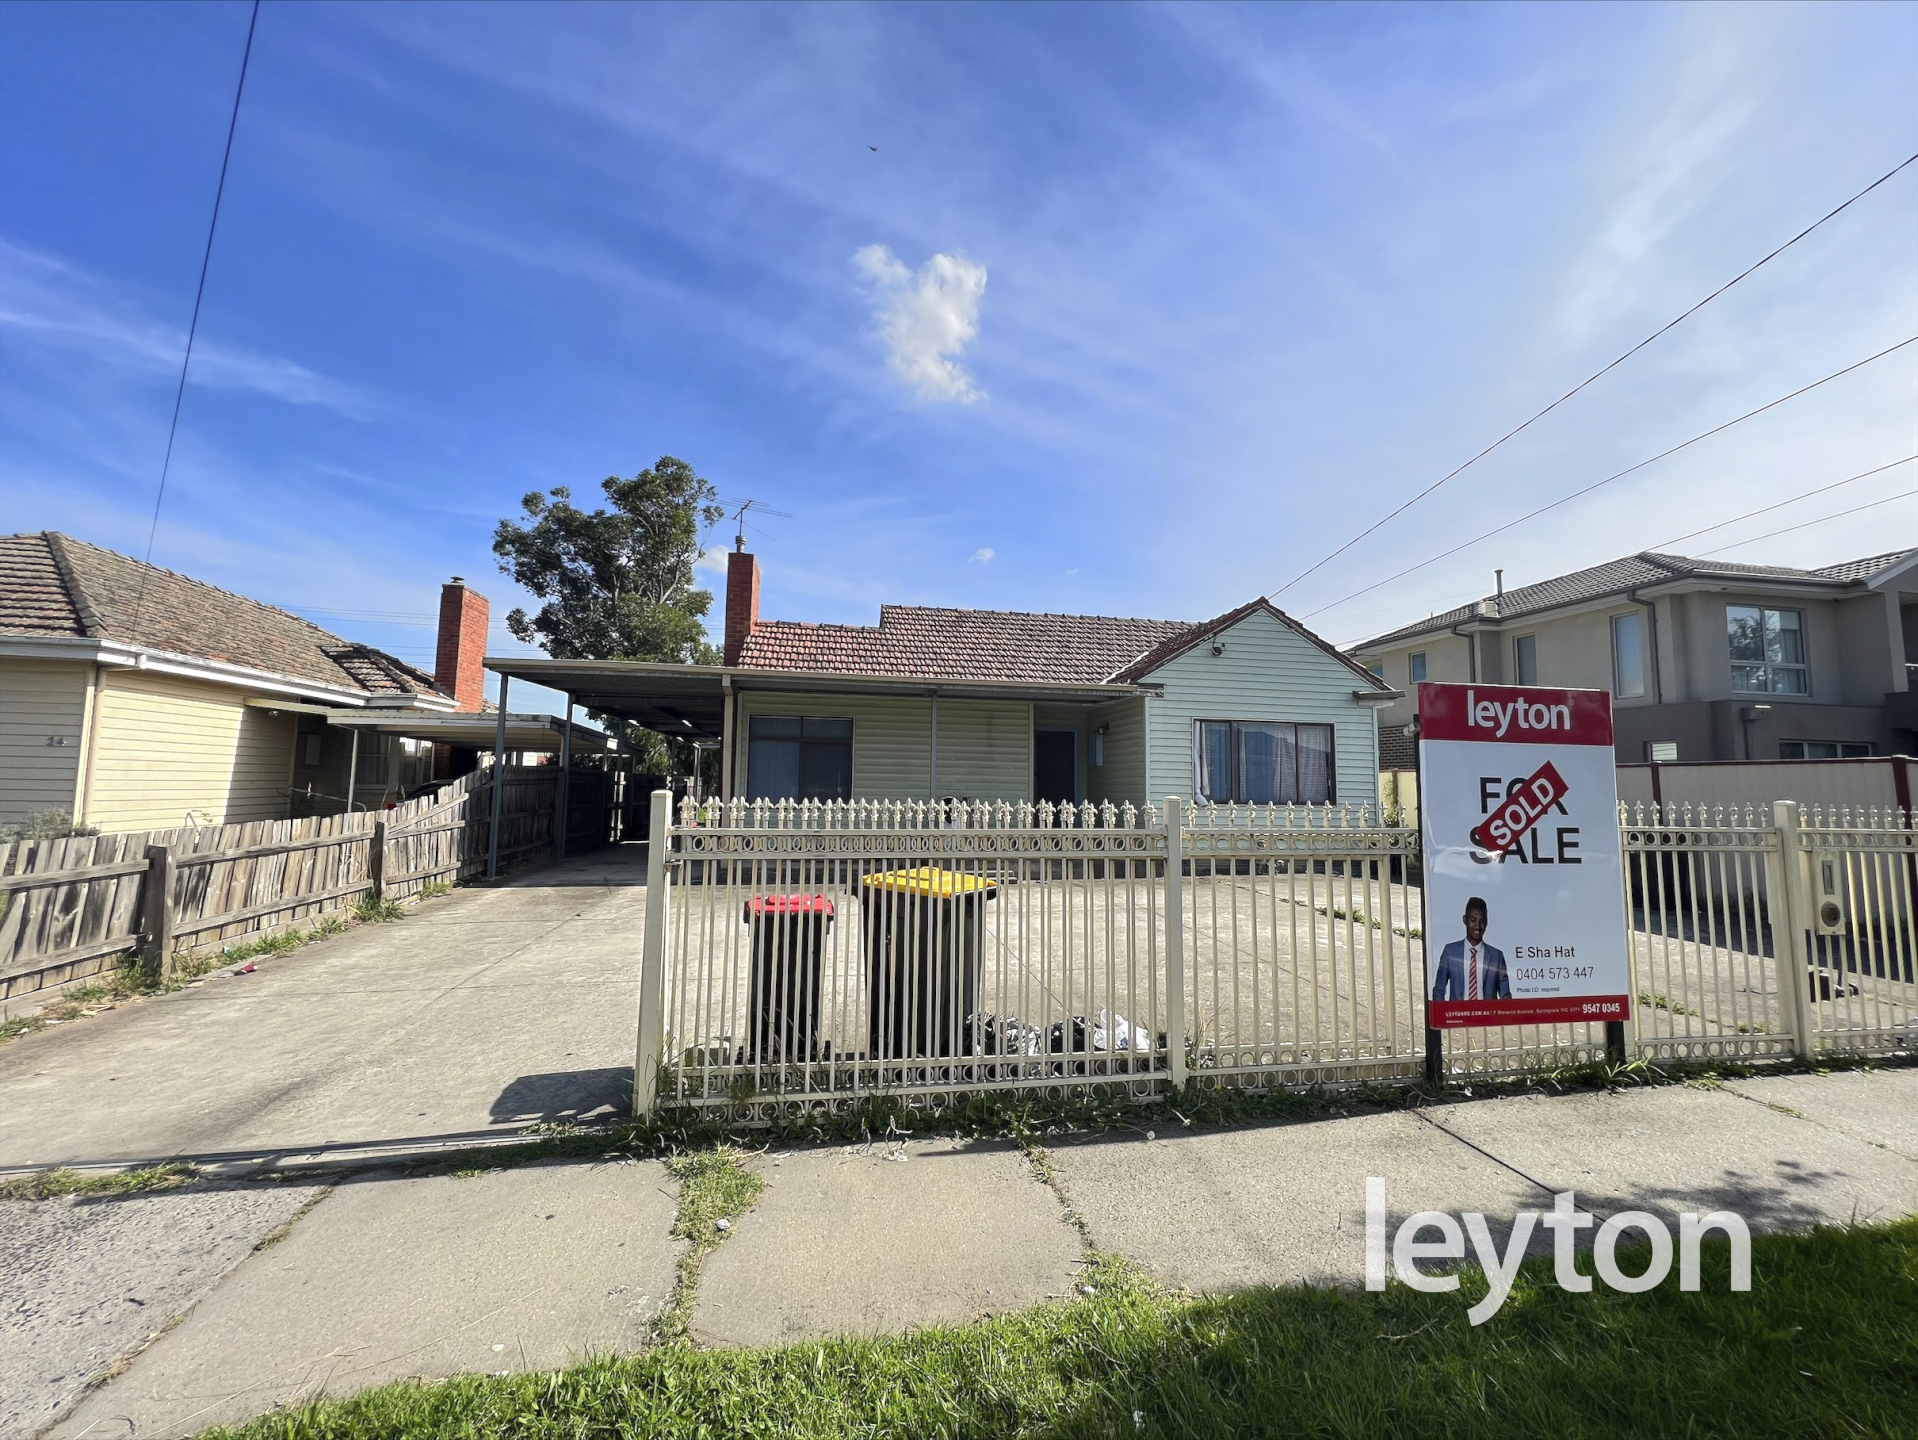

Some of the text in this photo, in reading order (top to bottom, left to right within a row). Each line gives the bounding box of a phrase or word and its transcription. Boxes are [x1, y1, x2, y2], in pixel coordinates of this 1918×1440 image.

[1468, 690, 1570, 737] leyton
[1489, 777, 1555, 846] SOLD
[1515, 946, 1575, 958] E Sha Hat
[1516, 966, 1594, 980] 0404 573 447
[1582, 1002, 1620, 1014] 9547 0345
